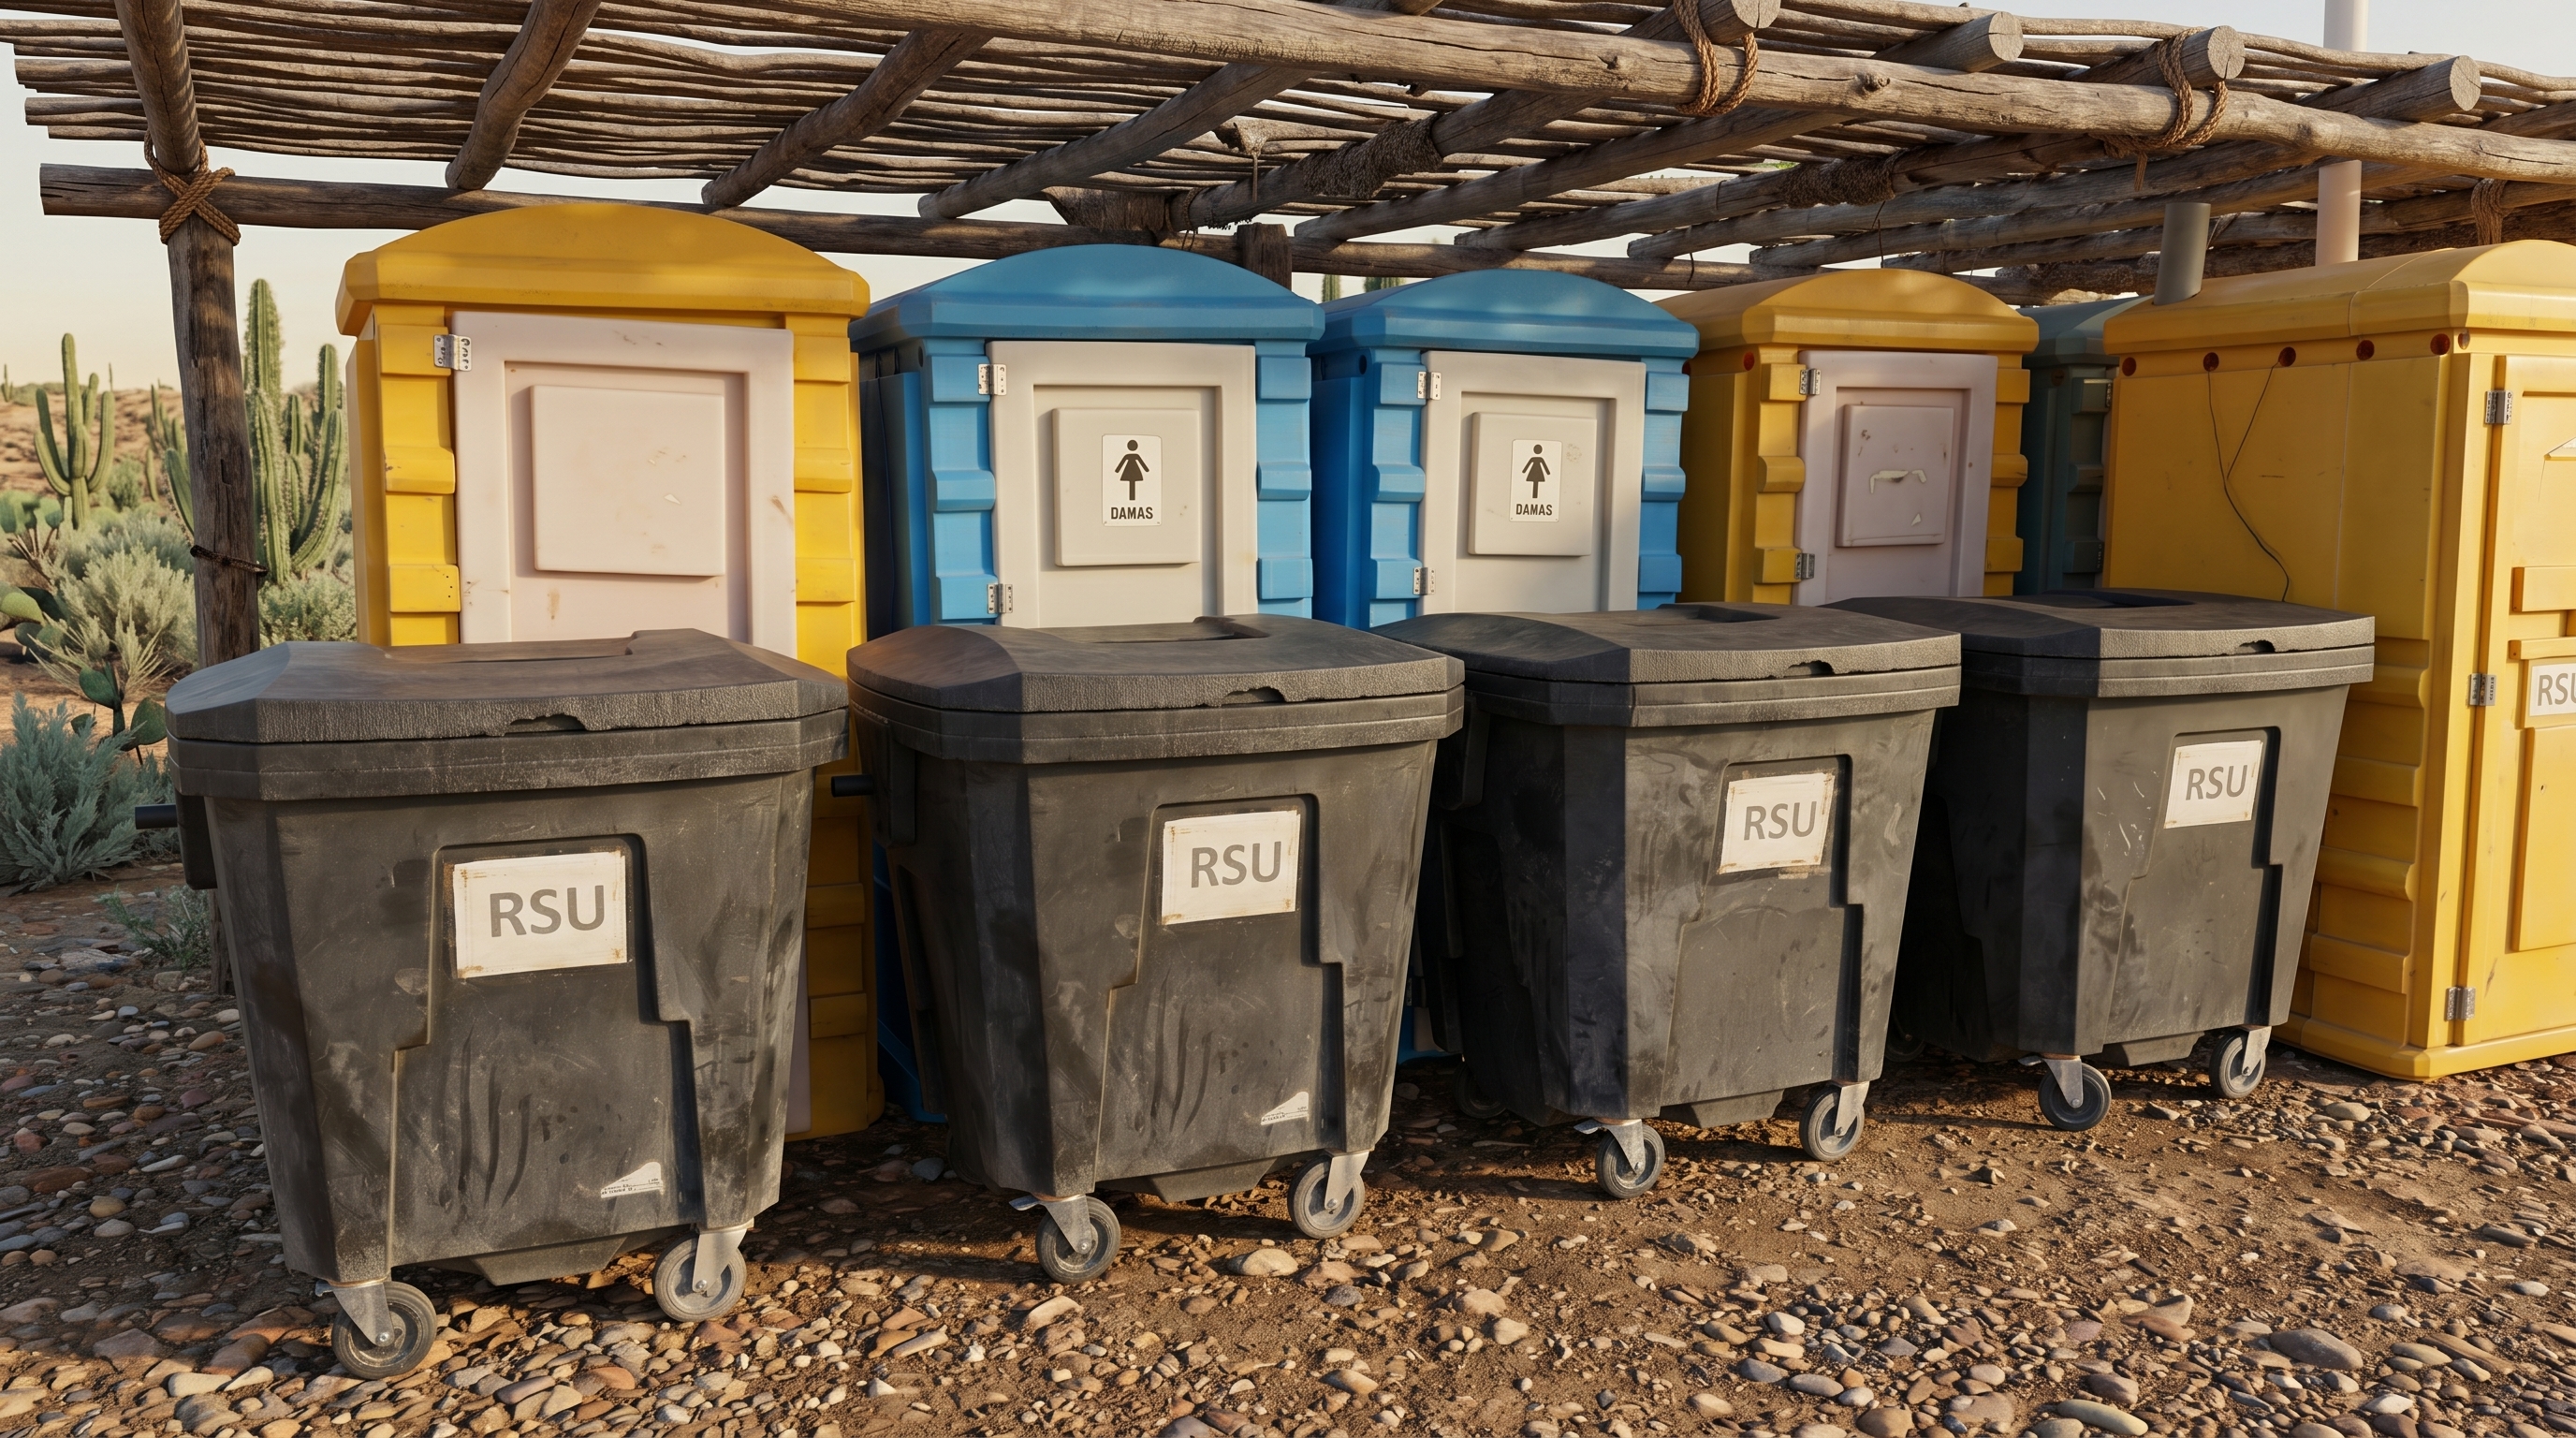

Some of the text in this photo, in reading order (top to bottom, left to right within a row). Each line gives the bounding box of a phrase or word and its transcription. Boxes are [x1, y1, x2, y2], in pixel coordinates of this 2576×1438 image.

[1110, 506, 1154, 520] DAMAS
[1515, 503, 1553, 516] DAMAS
[2185, 764, 2248, 801] RSU
[1743, 800, 1818, 841] RSU
[1191, 841, 1282, 888] RSU
[490, 885, 605, 938] RSU
